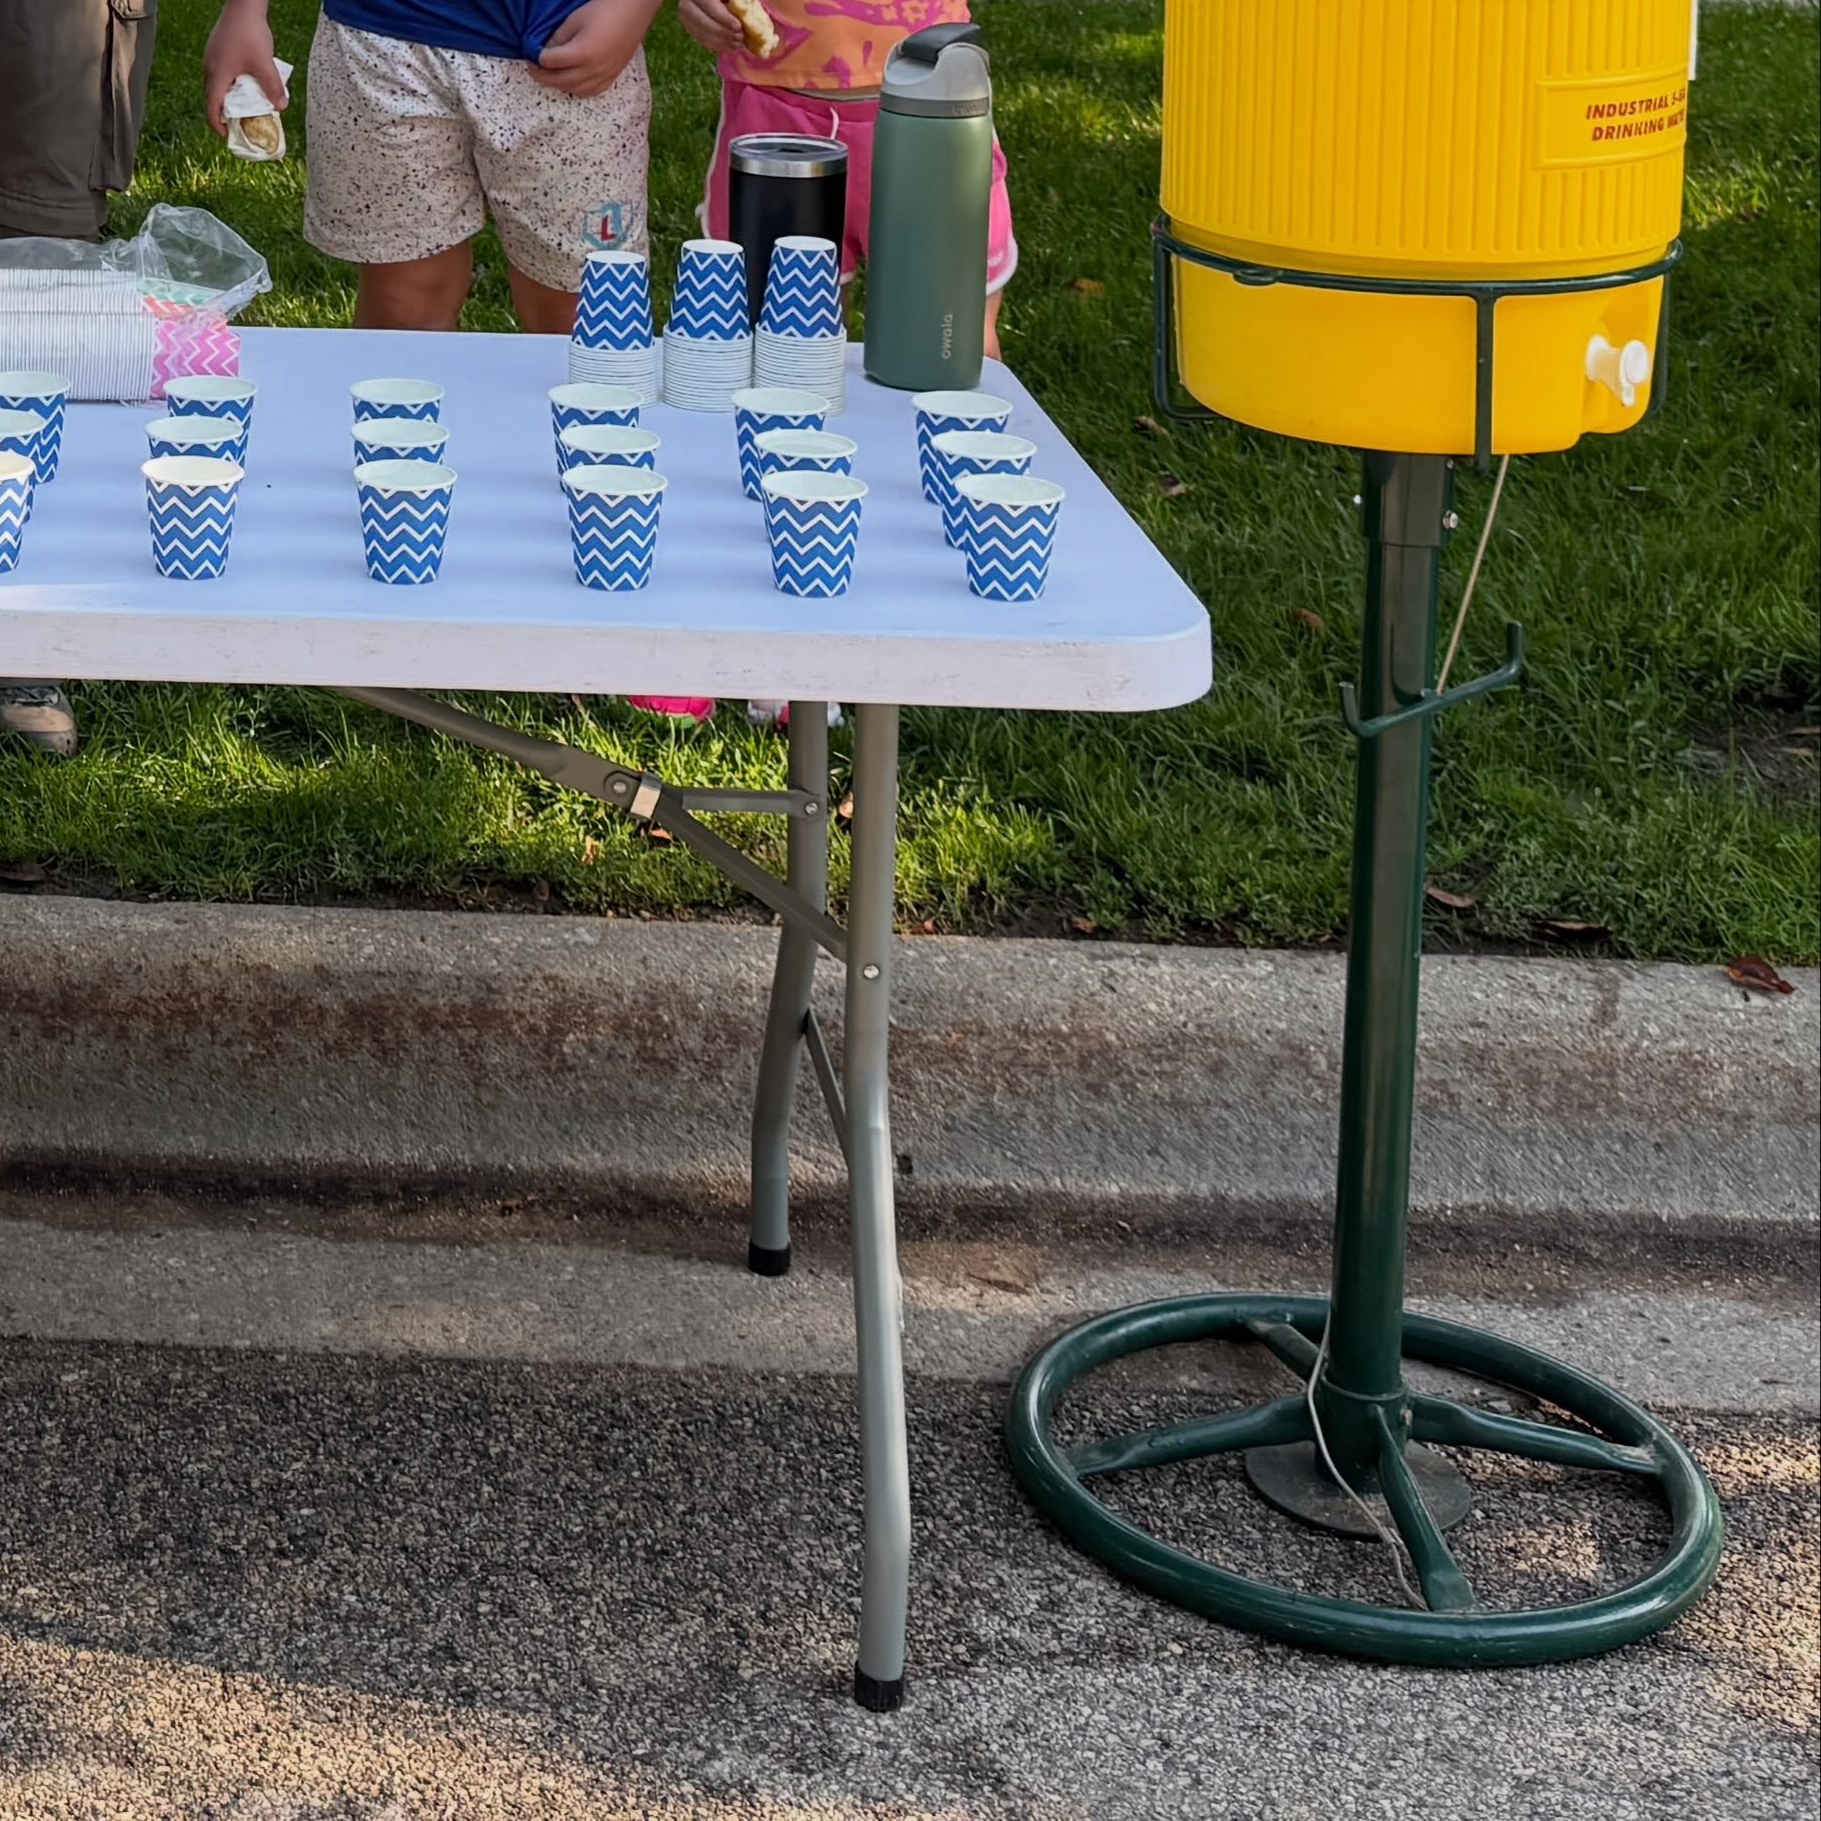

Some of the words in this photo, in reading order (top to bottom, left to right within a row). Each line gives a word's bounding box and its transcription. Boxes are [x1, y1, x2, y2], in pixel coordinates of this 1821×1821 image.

[1587, 95, 1668, 120] INDUSTRIAL
[1592, 117, 1665, 141] DRINKING
[941, 314, 953, 359] owala
